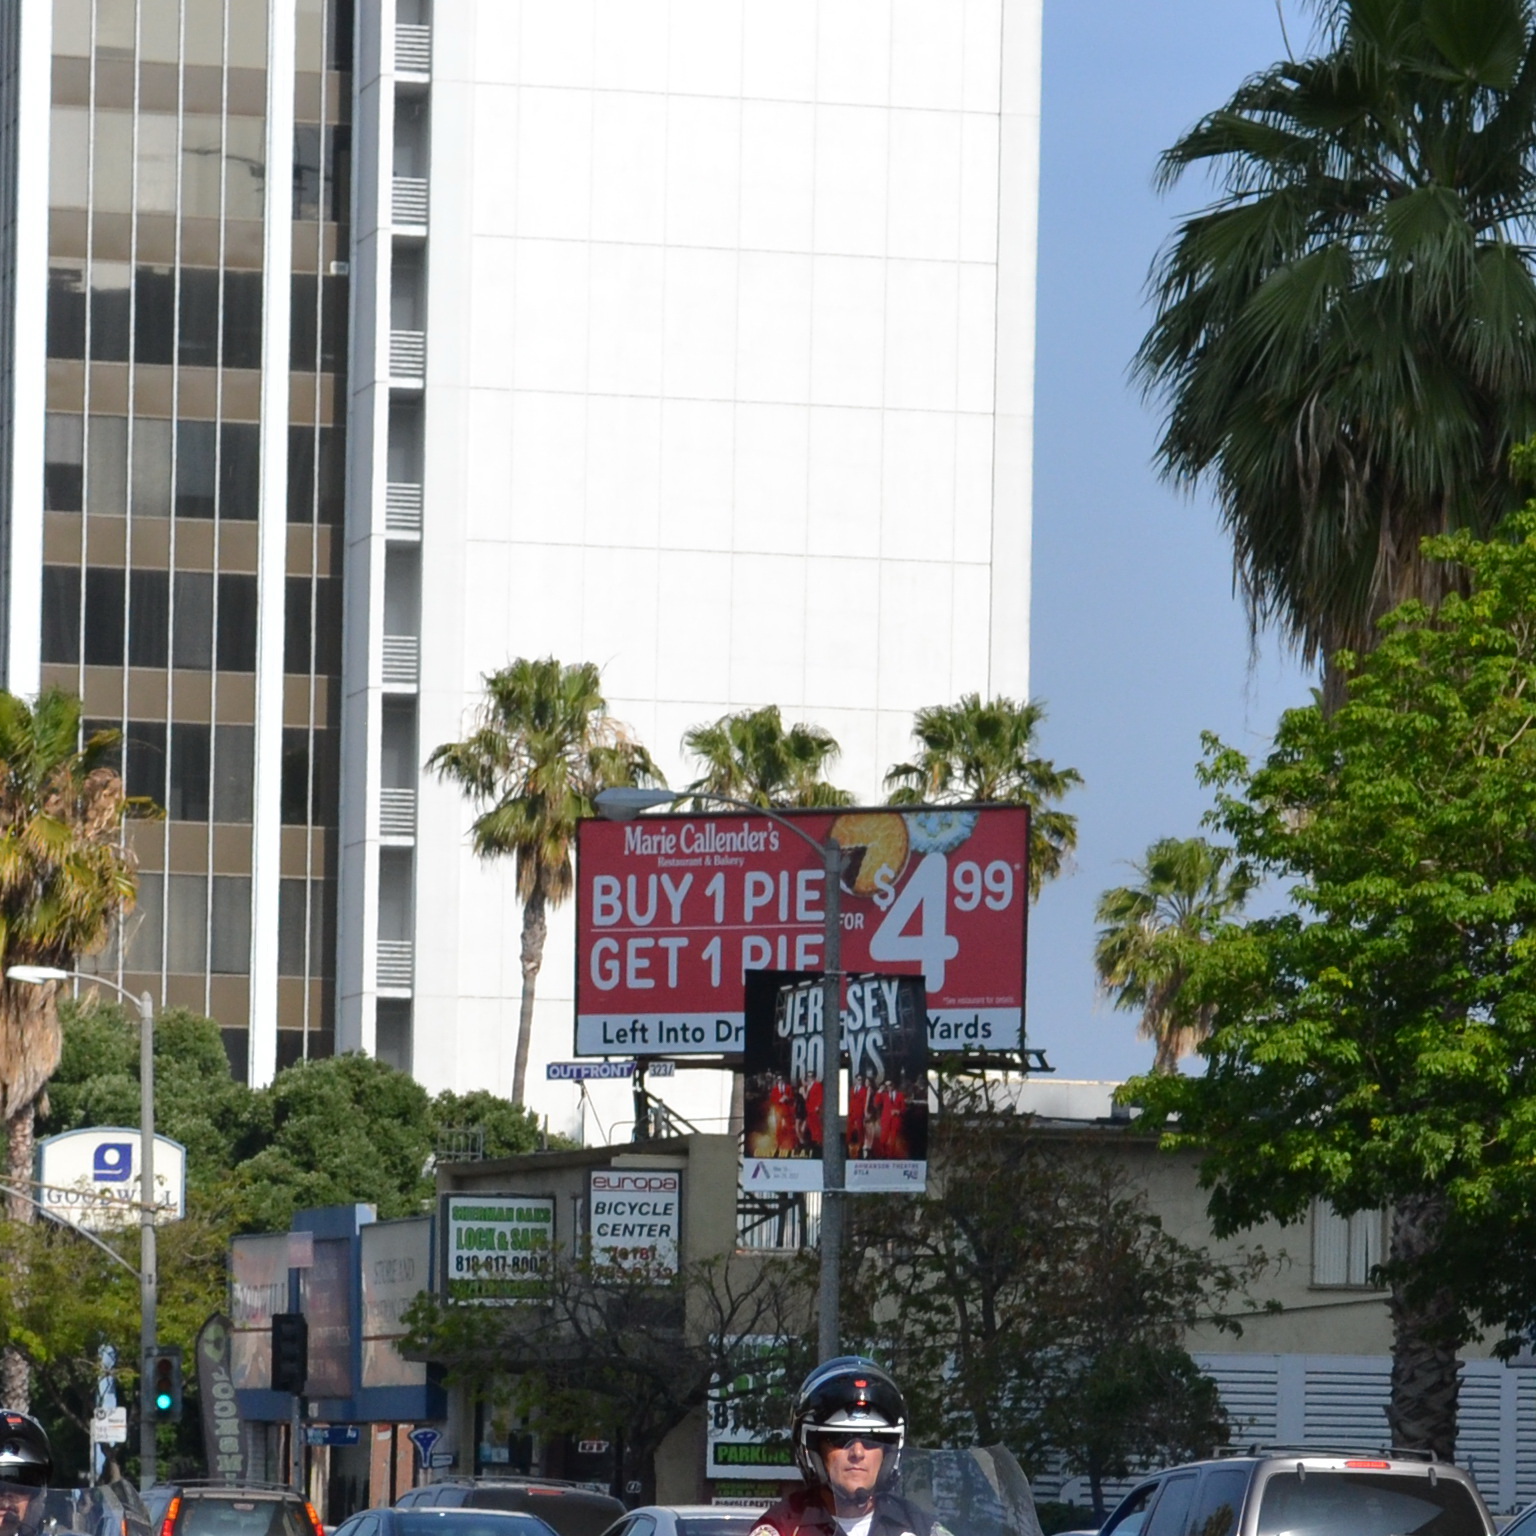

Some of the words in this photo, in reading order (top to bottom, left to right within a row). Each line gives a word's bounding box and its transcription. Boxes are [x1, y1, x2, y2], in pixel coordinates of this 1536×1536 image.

[624, 826, 676, 855] Marie
[680, 821, 779, 853] Callender's
[657, 856, 702, 867] Restaurant
[704, 857, 712, 866] &
[714, 856, 744, 868] Bakery
[592, 873, 693, 926] BUY
[705, 872, 725, 923] 1
[744, 869, 825, 923] PIE
[591, 936, 688, 990] GET
[701, 936, 721, 988] 1
[778, 977, 900, 1037] JERSEY
[602, 1020, 648, 1044] Left
[658, 1020, 704, 1043] Into
[715, 1019, 744, 1042] Dr
[926, 1014, 992, 1040] Yards
[791, 1028, 886, 1086] BOYS
[549, 1063, 634, 1079] OUTFRONT
[593, 1176, 677, 1193] europa
[47, 1188, 177, 1207] GOODWL
[452, 1206, 514, 1222] SHERMAN
[516, 1207, 551, 1223] OAKS
[594, 1201, 674, 1216] BICYCLE
[456, 1227, 496, 1251] LOCK
[497, 1231, 509, 1250] &
[510, 1228, 548, 1251] SAFE
[596, 1223, 671, 1238] CENTER
